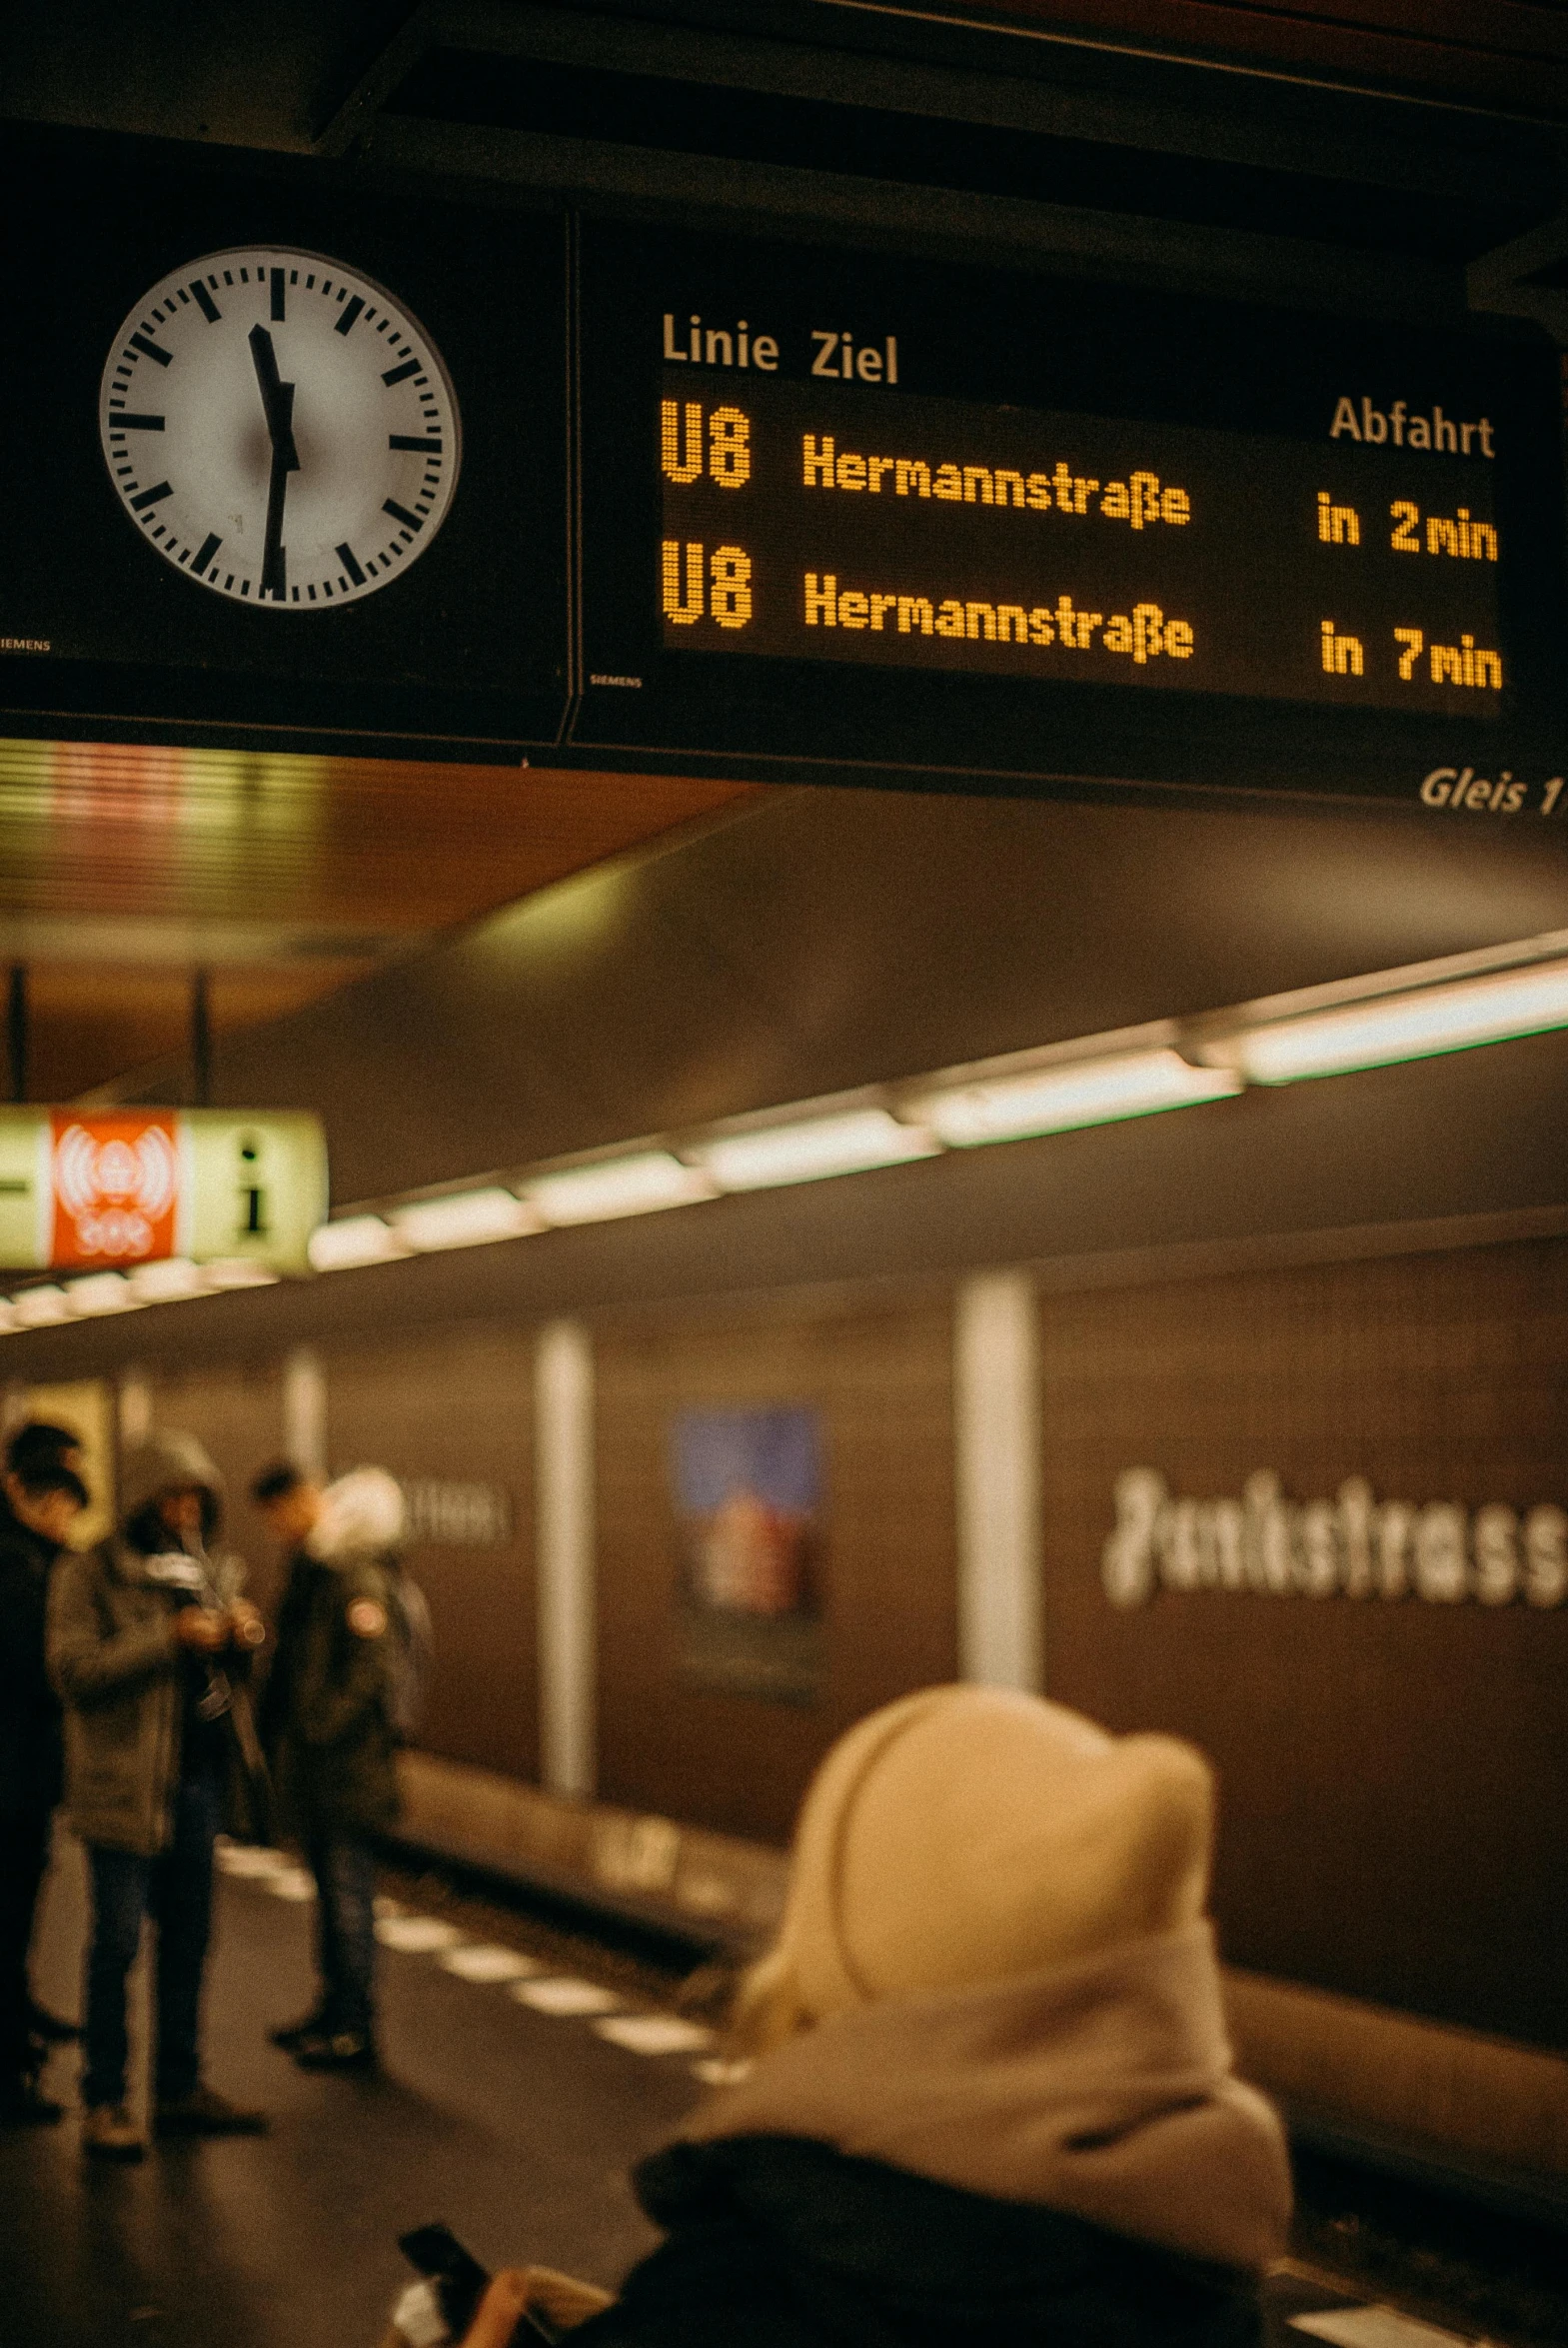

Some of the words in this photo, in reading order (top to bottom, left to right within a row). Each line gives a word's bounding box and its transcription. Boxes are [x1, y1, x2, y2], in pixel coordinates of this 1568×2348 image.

[665, 315, 778, 370] Linie
[812, 332, 896, 383] Ziel
[1330, 397, 1495, 457] Abfahrt
[662, 400, 751, 488] U8
[803, 435, 1190, 529] Hermannstraße
[1318, 492, 1359, 545] in
[663, 541, 752, 629] U8
[804, 573, 1193, 664] Hermannstraße
[1321, 621, 1363, 675] in
[590, 674, 643, 689] SIEMENS
[1421, 769, 1527, 811] Gleis
[1542, 779, 1562, 814] 1
